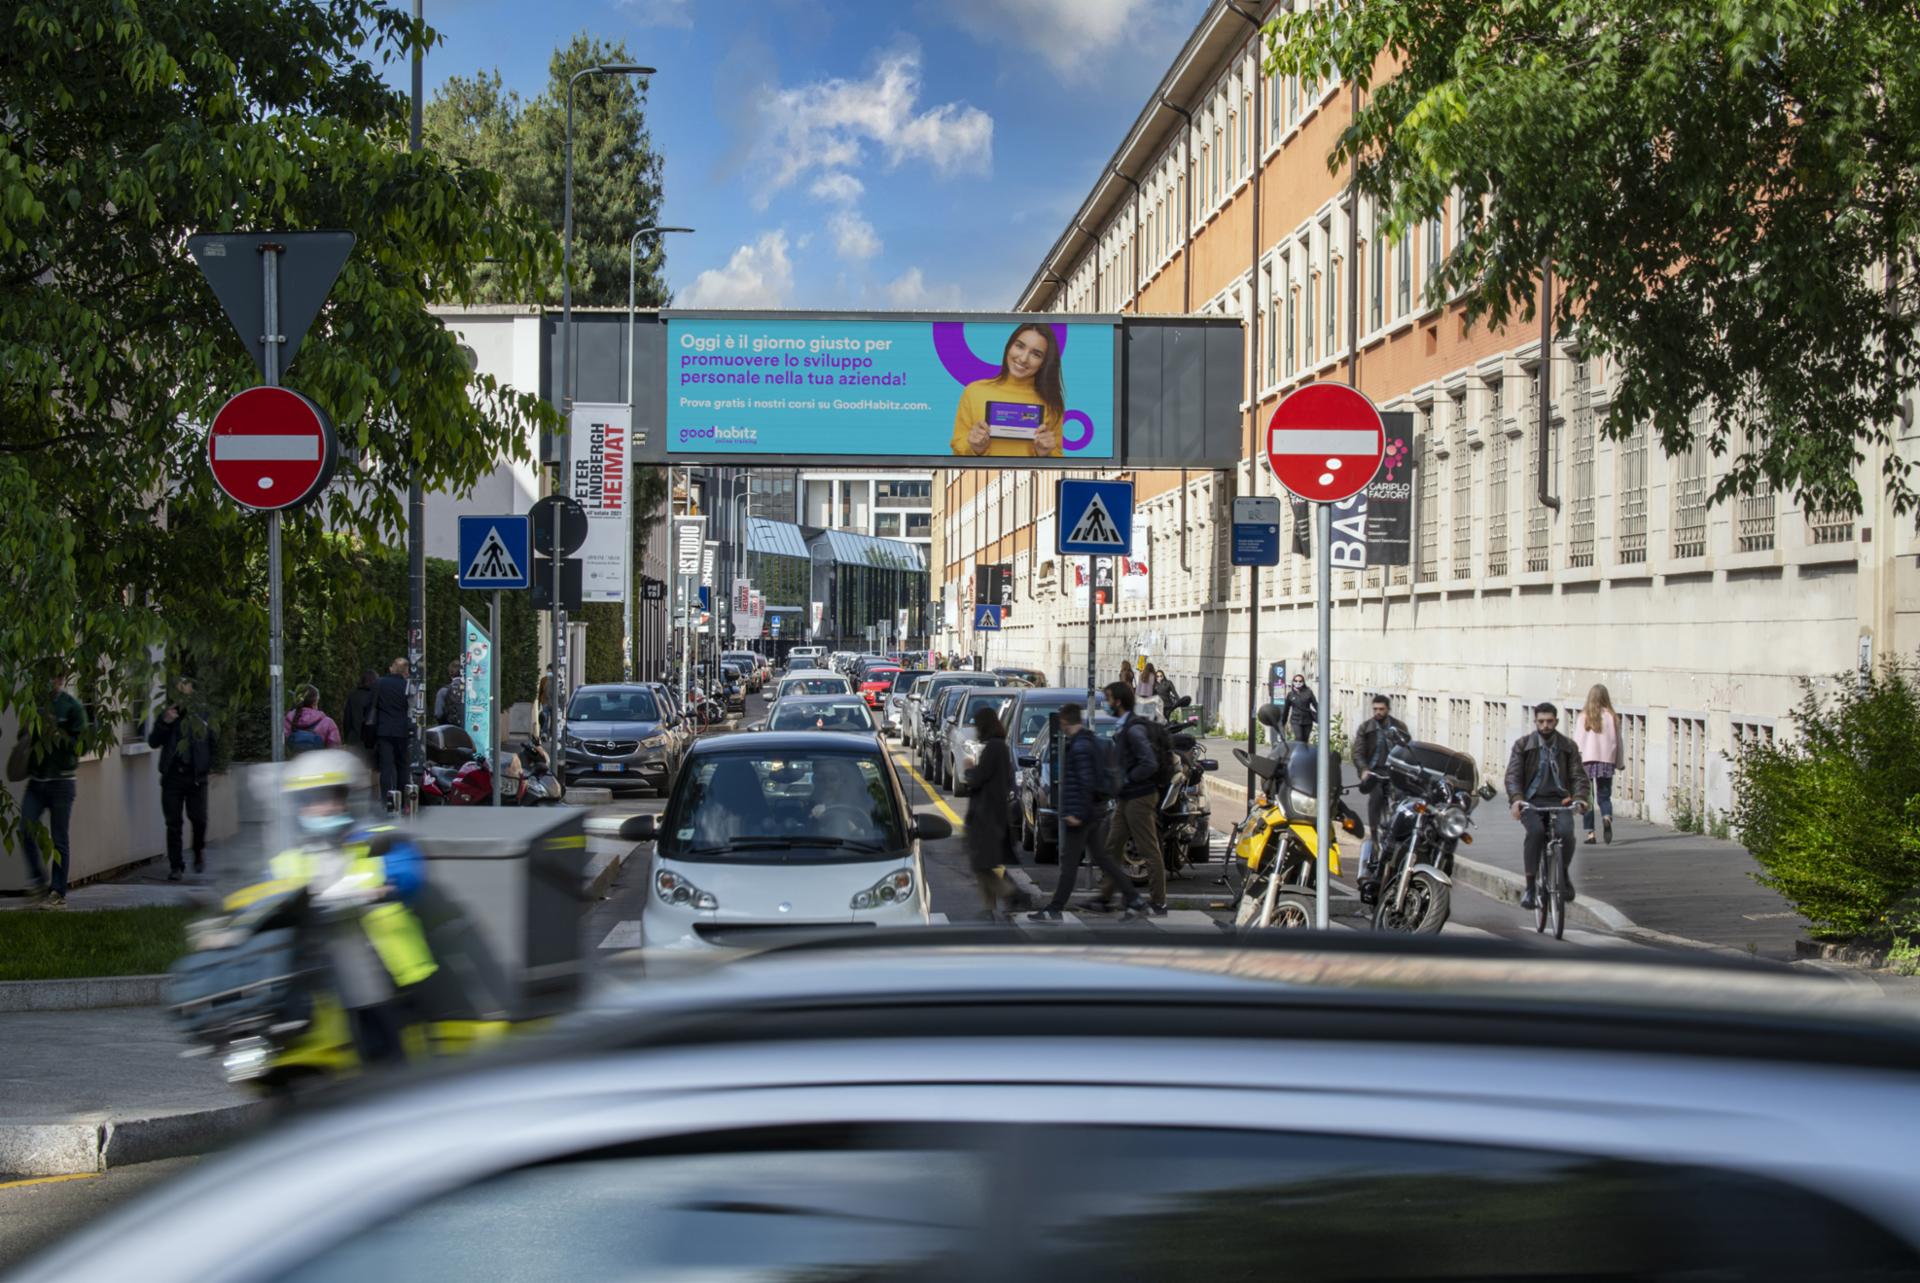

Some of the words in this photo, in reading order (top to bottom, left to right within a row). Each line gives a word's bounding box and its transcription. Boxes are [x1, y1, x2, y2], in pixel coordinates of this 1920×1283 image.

[680, 333, 720, 352] Oggi
[724, 335, 735, 349] è
[739, 334, 749, 349] il
[752, 334, 806, 353] giorno
[809, 335, 861, 353] giusto
[864, 340, 893, 353] per
[681, 354, 780, 369] promuovere
[785, 352, 799, 367] lo
[803, 353, 873, 371] sviluppo
[681, 369, 761, 386] personale
[764, 370, 803, 385] nella
[807, 372, 834, 385] tua
[839, 371, 907, 386] azienda!
[680, 397, 712, 408] Prova
[714, 398, 745, 410] gratis
[748, 398, 752, 408] i
[754, 398, 786, 408] nostri
[788, 399, 815, 409] corsi
[818, 400, 830, 409] su
[833, 400, 932, 410] GoodHabitz.com.
[589, 423, 604, 509] LINDBERGH
[603, 423, 624, 509] HEIMAT
[575, 459, 589, 508] PETER
[1369, 482, 1410, 491] CARIPLO
[1368, 490, 1409, 499] FACTORY
[679, 525, 700, 575] RSTUDIO
